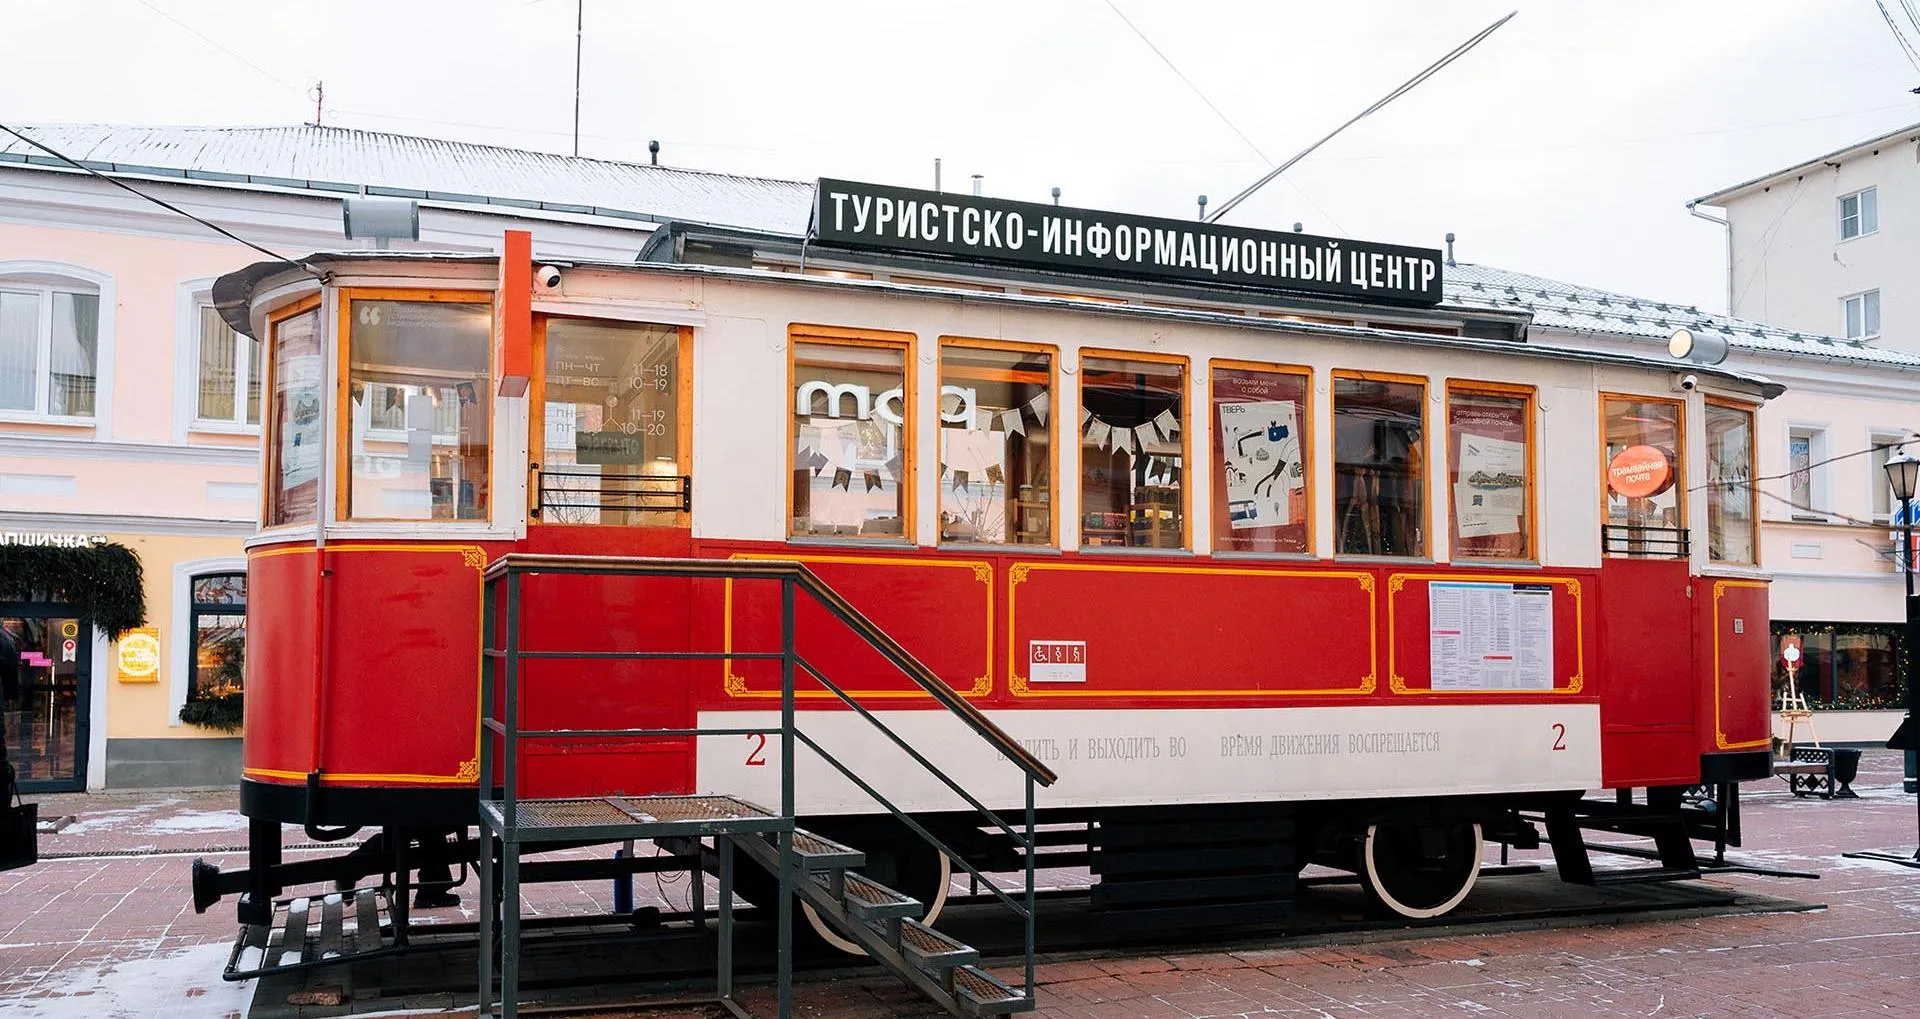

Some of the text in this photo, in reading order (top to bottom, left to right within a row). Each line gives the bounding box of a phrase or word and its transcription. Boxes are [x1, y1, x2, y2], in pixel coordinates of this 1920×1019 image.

[829, 191, 1437, 292] ТУРИСТСКО-ИНФОРМАЦИОННЫЙ ЦЕНТР
[1222, 404, 1246, 414] ТВЕРЬ
[1625, 472, 1651, 484] почта
[745, 733, 766, 766] 2
[1069, 738, 1078, 760] И
[1088, 736, 1160, 761] ВЫХОДИТЬ
[1169, 736, 1187, 758] ВО
[1221, 731, 1440, 759] ВРЕМЯ ДВИЖЕНИЯ ВОСПРЕЩАЕТСЯ
[1552, 723, 1566, 751] 2
